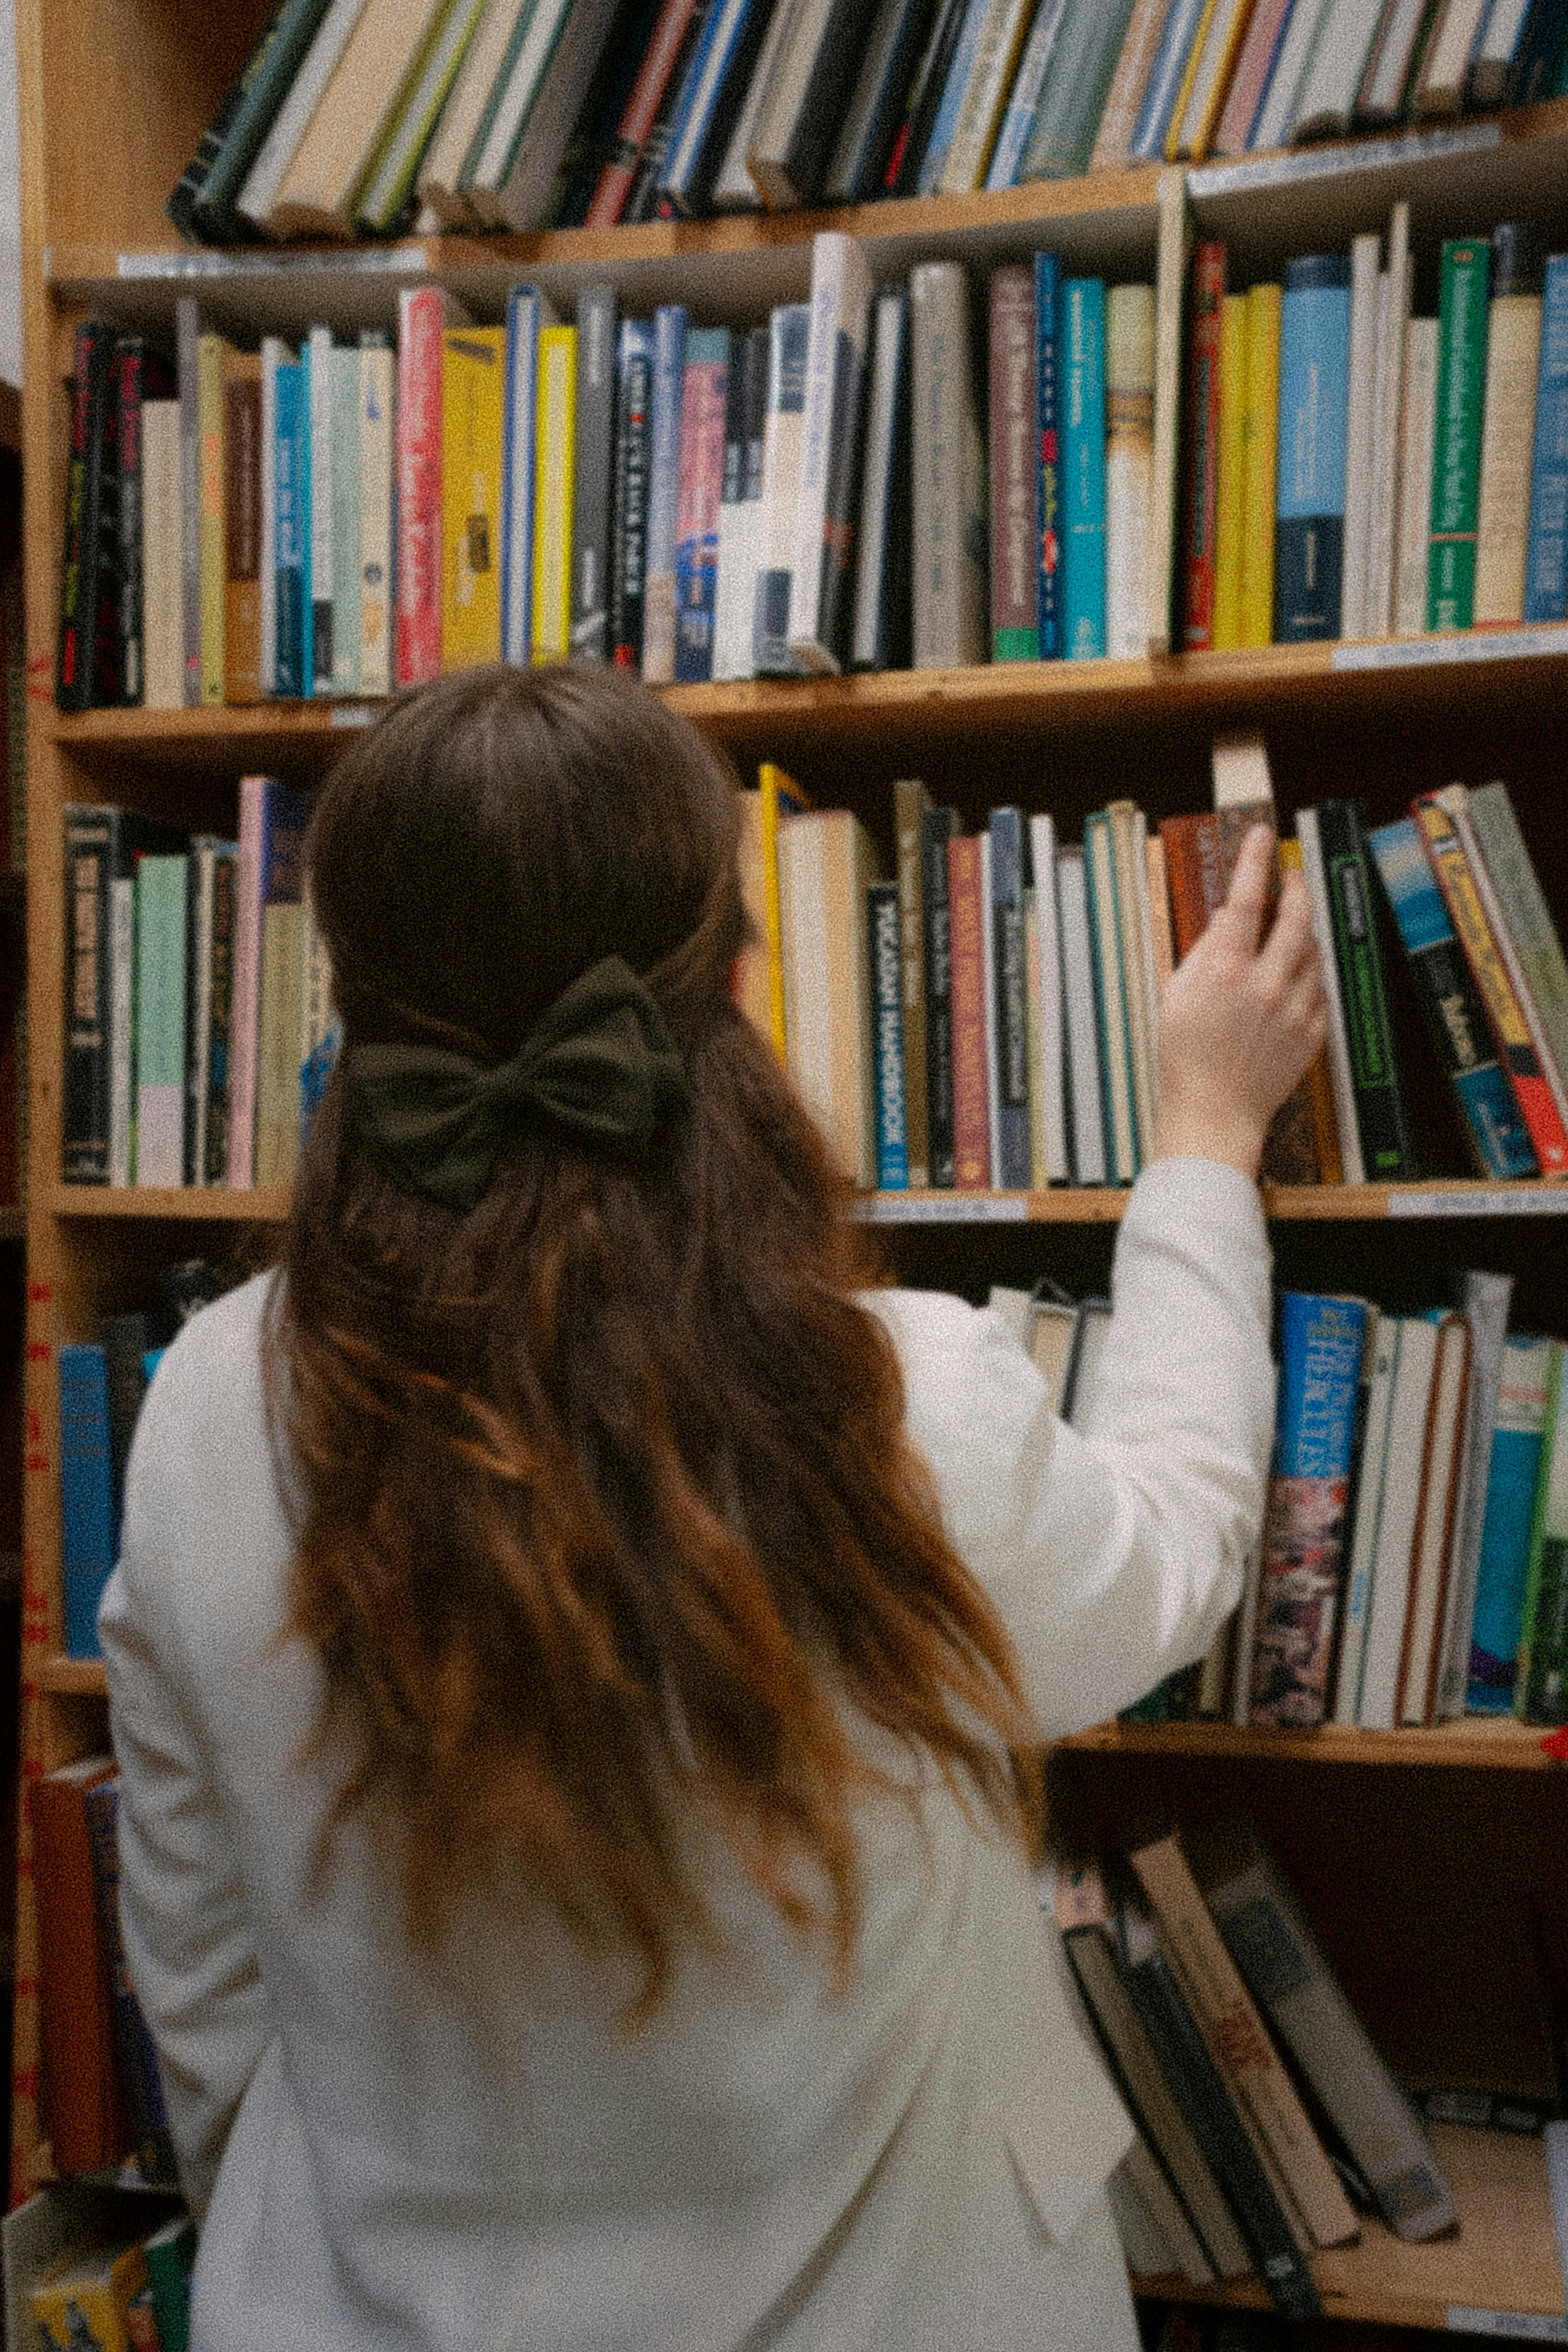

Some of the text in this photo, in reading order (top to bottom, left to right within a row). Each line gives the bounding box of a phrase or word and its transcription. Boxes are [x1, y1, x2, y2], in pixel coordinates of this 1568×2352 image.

[878, 903, 898, 1005] YUCATAN
[880, 1011, 904, 1145] HANDBOOK
[1297, 1341, 1337, 1477] HERCULES
